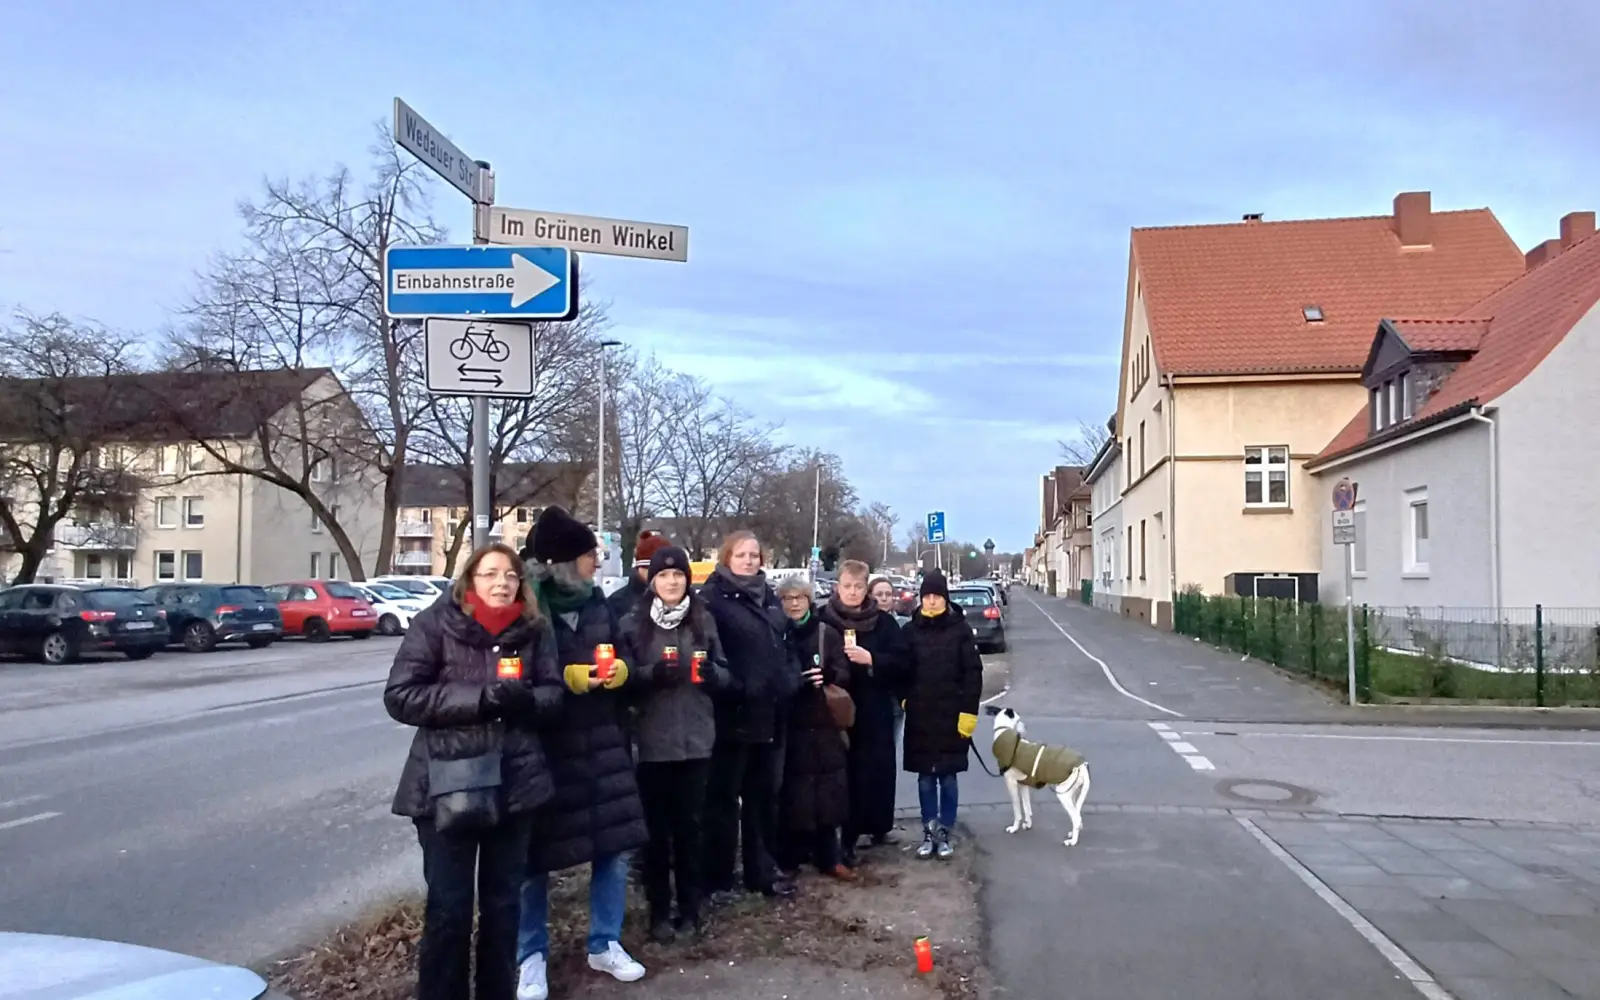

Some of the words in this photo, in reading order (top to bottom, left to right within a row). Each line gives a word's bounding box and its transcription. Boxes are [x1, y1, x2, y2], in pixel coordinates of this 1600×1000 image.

[405, 113, 454, 171] Wedauer
[501, 213, 524, 236] Im
[534, 217, 601, 244] Grünen
[612, 224, 674, 251] Winkel
[397, 273, 515, 289] Einbahnstraße
